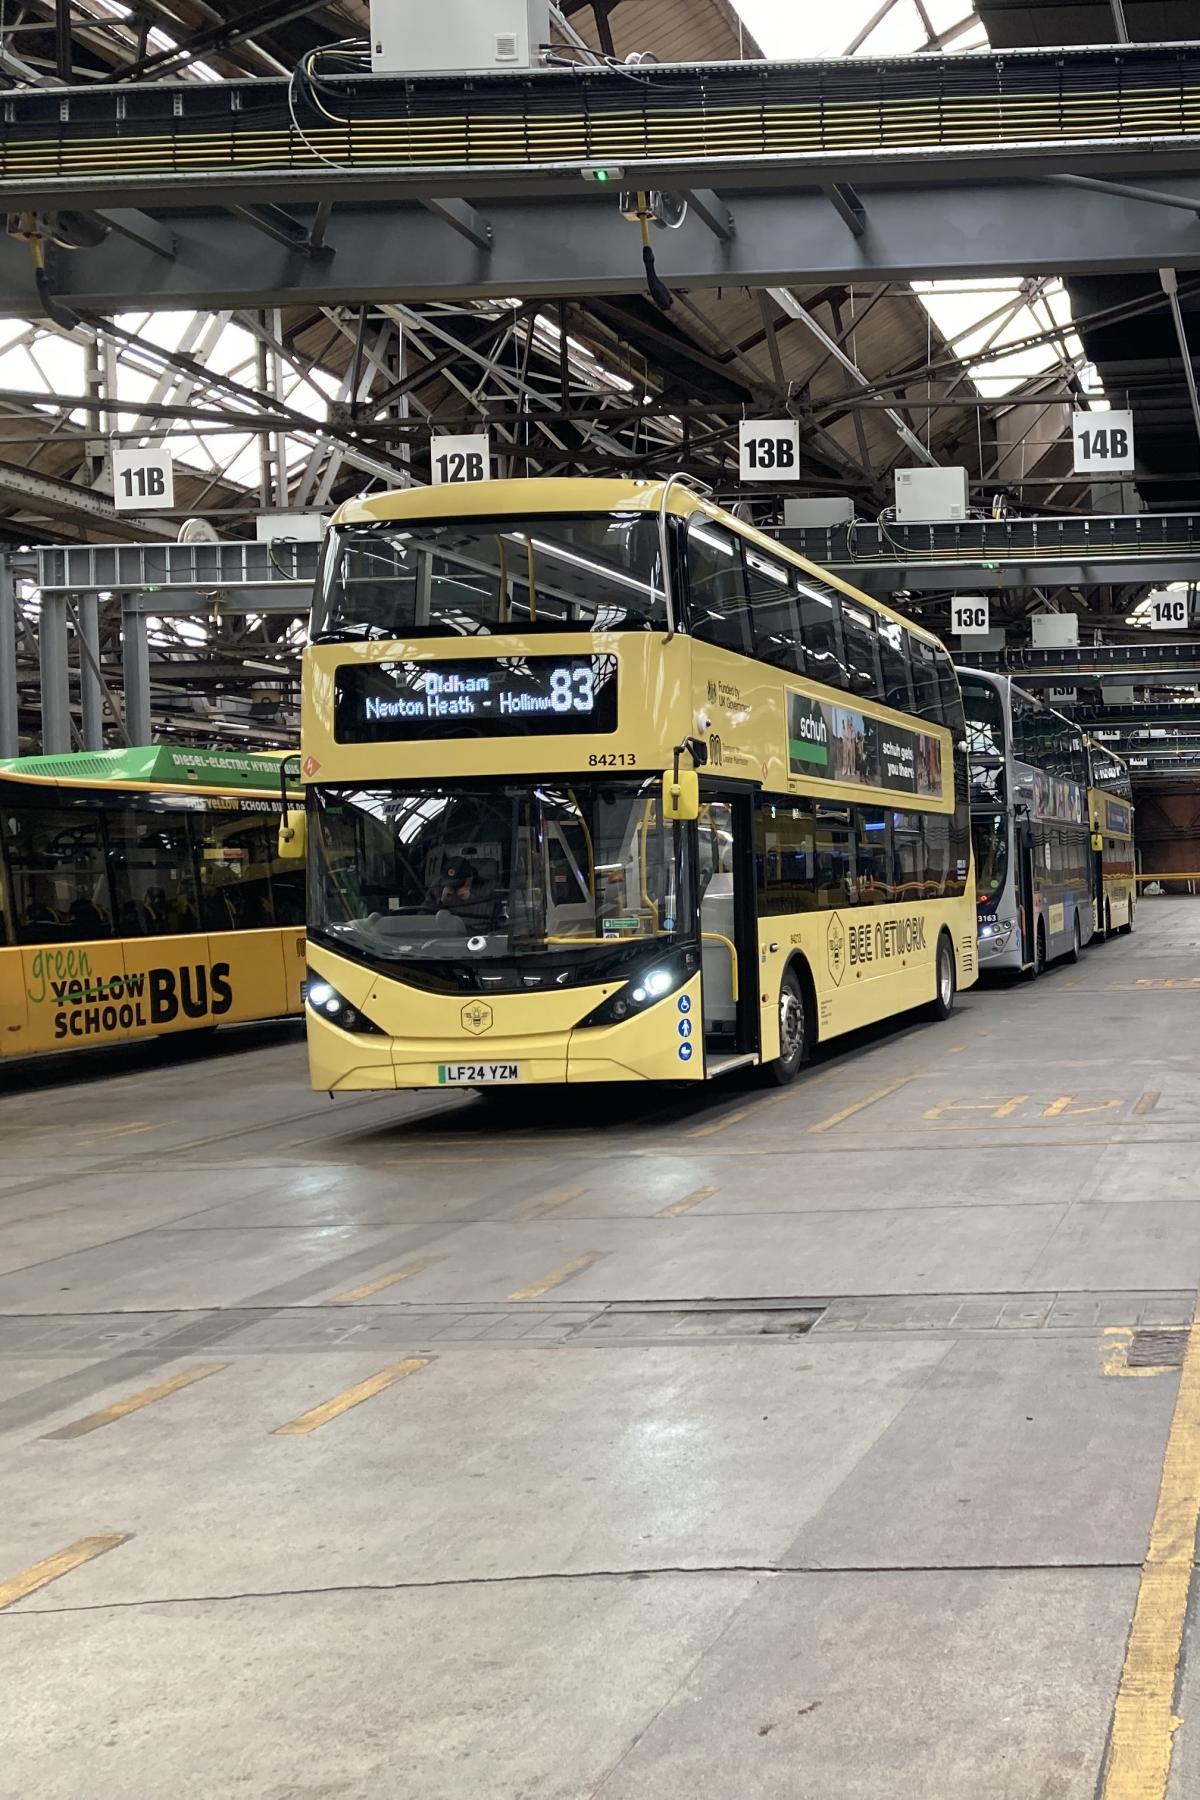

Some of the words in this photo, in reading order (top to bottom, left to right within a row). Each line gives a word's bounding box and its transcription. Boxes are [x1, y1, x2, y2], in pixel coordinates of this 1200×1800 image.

[744, 438, 795, 468] 13B
[1078, 429, 1128, 459] 14B
[436, 453, 483, 481] 12B
[120, 468, 165, 496] 11B
[954, 607, 986, 627] 13C
[1153, 601, 1185, 621] 14C
[425, 672, 490, 695] Oldham
[550, 667, 595, 713] 83
[718, 681, 734, 697] Funded
[735, 686, 740, 700] by
[366, 697, 423, 719] Newton
[427, 695, 474, 717] Heath
[800, 714, 827, 743] schuh
[588, 753, 637, 767] 84213
[882, 741, 900, 758] schuh
[901, 745, 914, 762] gets
[887, 762, 899, 778] you
[899, 763, 915, 779] there
[240, 800, 271, 811] SCHOOL
[271, 802, 282, 812] BU
[977, 914, 997, 922] 3163
[848, 924, 873, 966] BEE
[875, 916, 926, 960] NETWORK
[28, 949, 93, 1003] green
[148, 962, 233, 1024] BUS
[54, 1003, 147, 1039] SCHOOL
[447, 1065, 486, 1081] LF24
[489, 1065, 518, 1080] YZM
